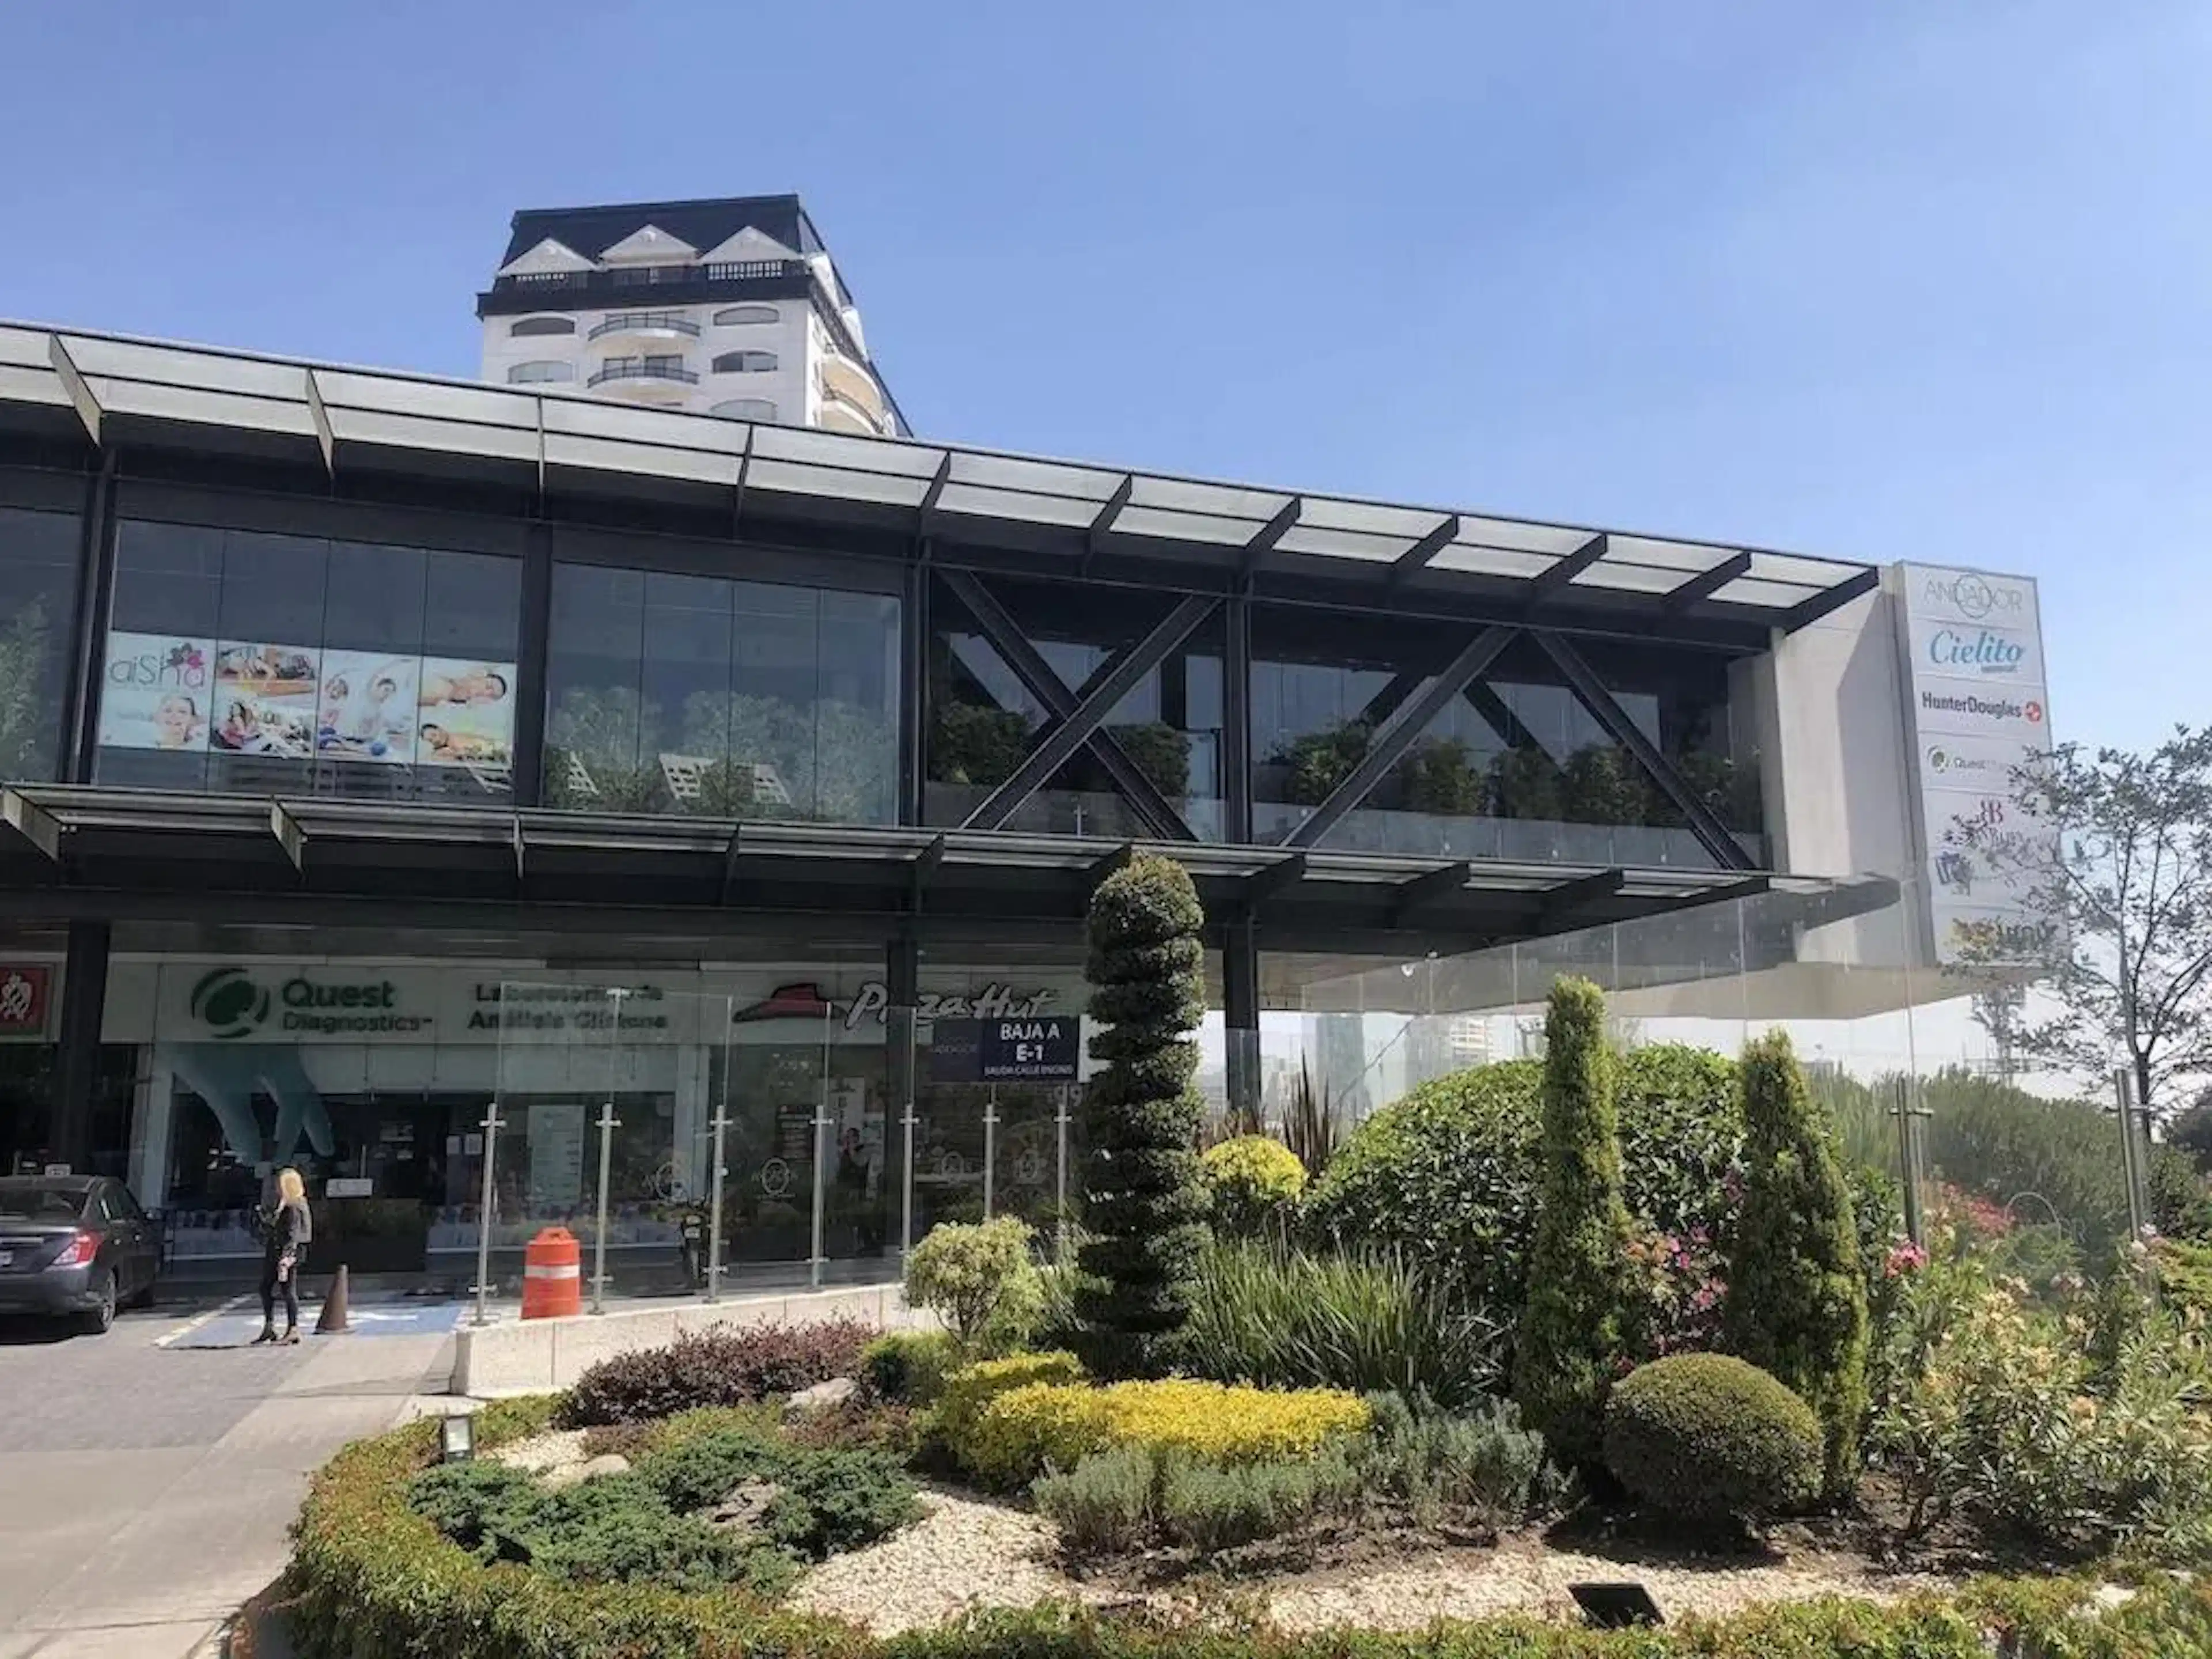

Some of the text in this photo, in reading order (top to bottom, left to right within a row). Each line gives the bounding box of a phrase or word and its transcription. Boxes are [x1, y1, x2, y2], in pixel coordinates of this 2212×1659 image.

[1931, 630, 2025, 664] Cielito
[282, 978, 396, 1008] Quest
[970, 982, 1060, 1020] Hut
[1001, 1022, 1060, 1040] BAJA A
[1016, 1044, 1044, 1062] E-1
